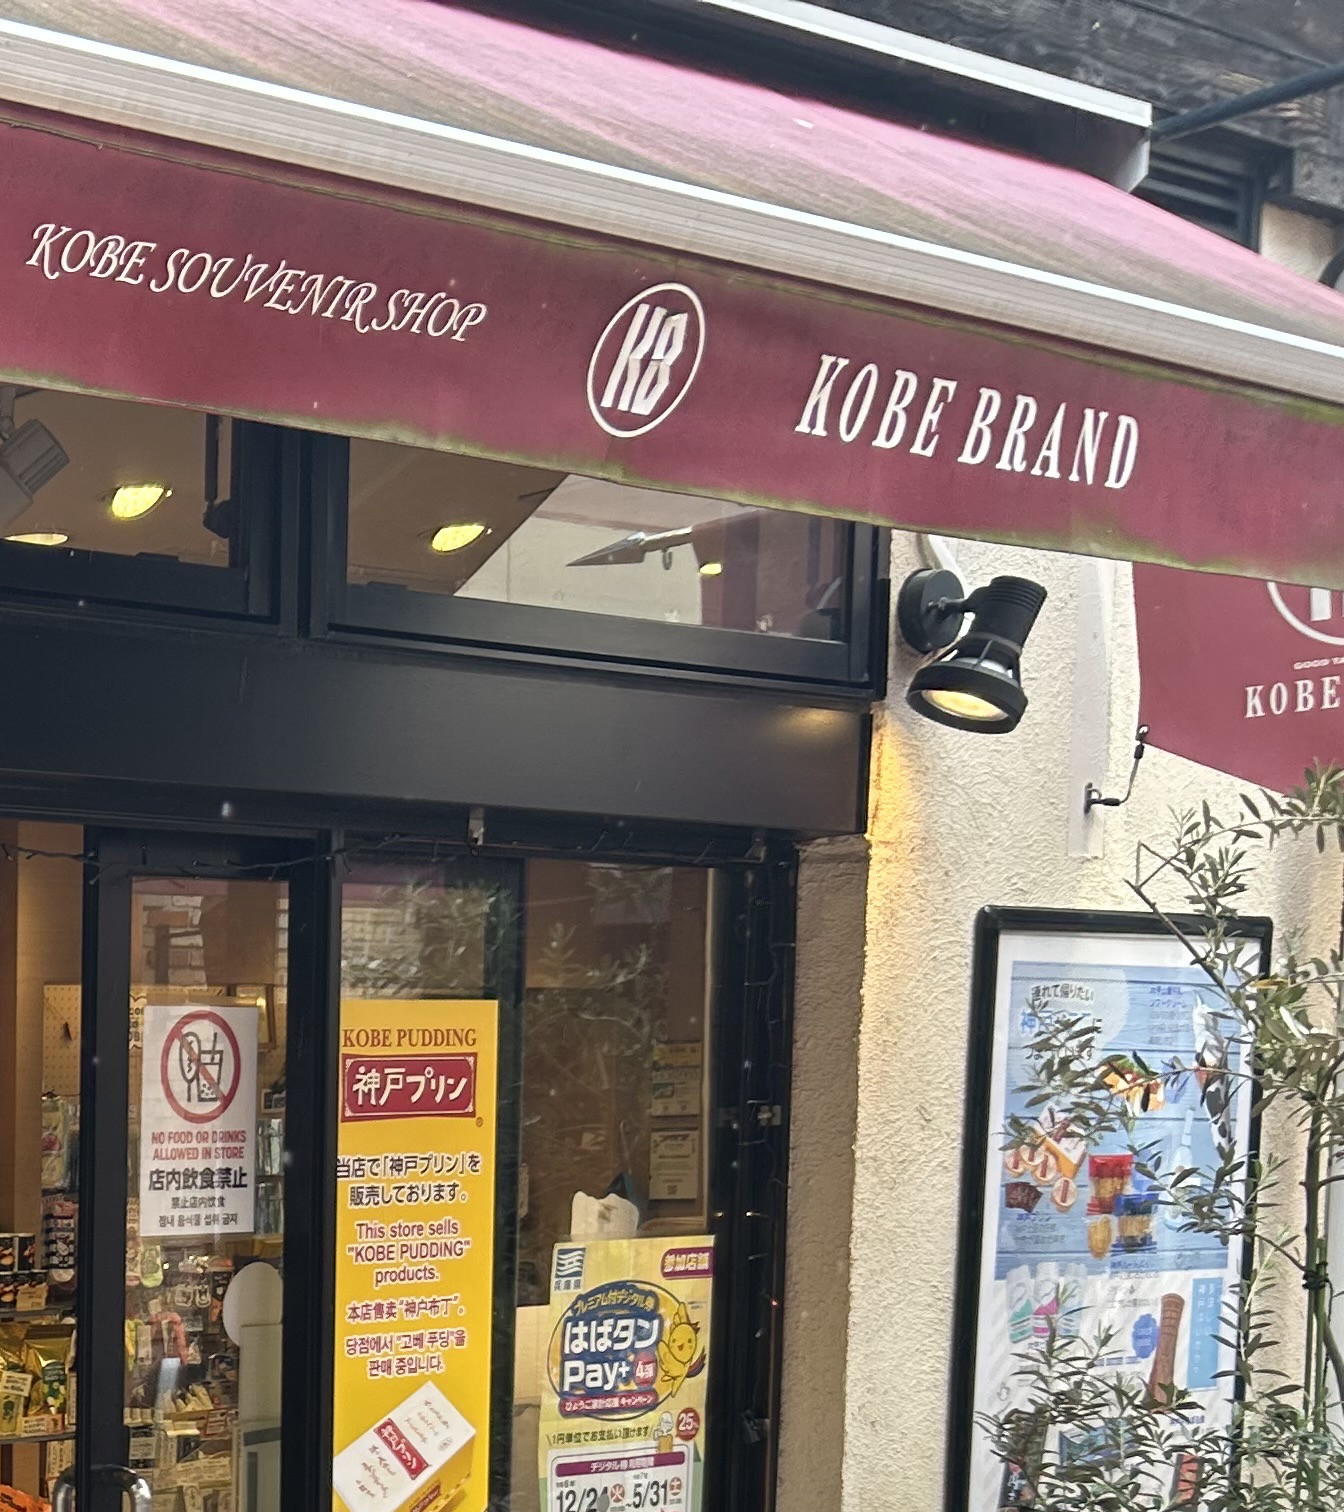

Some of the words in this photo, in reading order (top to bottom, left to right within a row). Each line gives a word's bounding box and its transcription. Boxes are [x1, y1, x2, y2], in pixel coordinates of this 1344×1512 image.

[27, 224, 154, 285] KOBE
[151, 248, 376, 333] SOUVENIR
[373, 288, 487, 343] SHOP
[795, 353, 957, 457] KOBE
[958, 387, 1139, 489] BRAND
[1245, 675, 1341, 718] KOBE
[343, 1028, 392, 1048] KOBE
[396, 1027, 477, 1048] PUDDING
[352, 1064, 468, 1106] 神戸プリン
[152, 1132, 165, 1144] NO
[168, 1131, 193, 1144] FOOD
[196, 1131, 209, 1143] OR
[212, 1130, 246, 1143] DRINKS
[153, 1147, 199, 1160] ALLOWED
[202, 1146, 212, 1159] IN
[214, 1146, 245, 1159] STORE
[337, 1153, 481, 1178] 当店で「神戸プリン」を
[149, 1166, 247, 1191] 店内飲食禁止
[350, 1182, 466, 1206] 販売しております。
[356, 1222, 385, 1239] This
[390, 1222, 424, 1238] store
[428, 1218, 459, 1235] sells
[348, 1244, 395, 1262] "KOBE
[400, 1240, 471, 1260] PUDDING"
[375, 1266, 440, 1287] products.
[564, 1319, 660, 1354] はばタン
[563, 1360, 630, 1391] Pay+
[633, 1479, 668, 1509] 5/31
